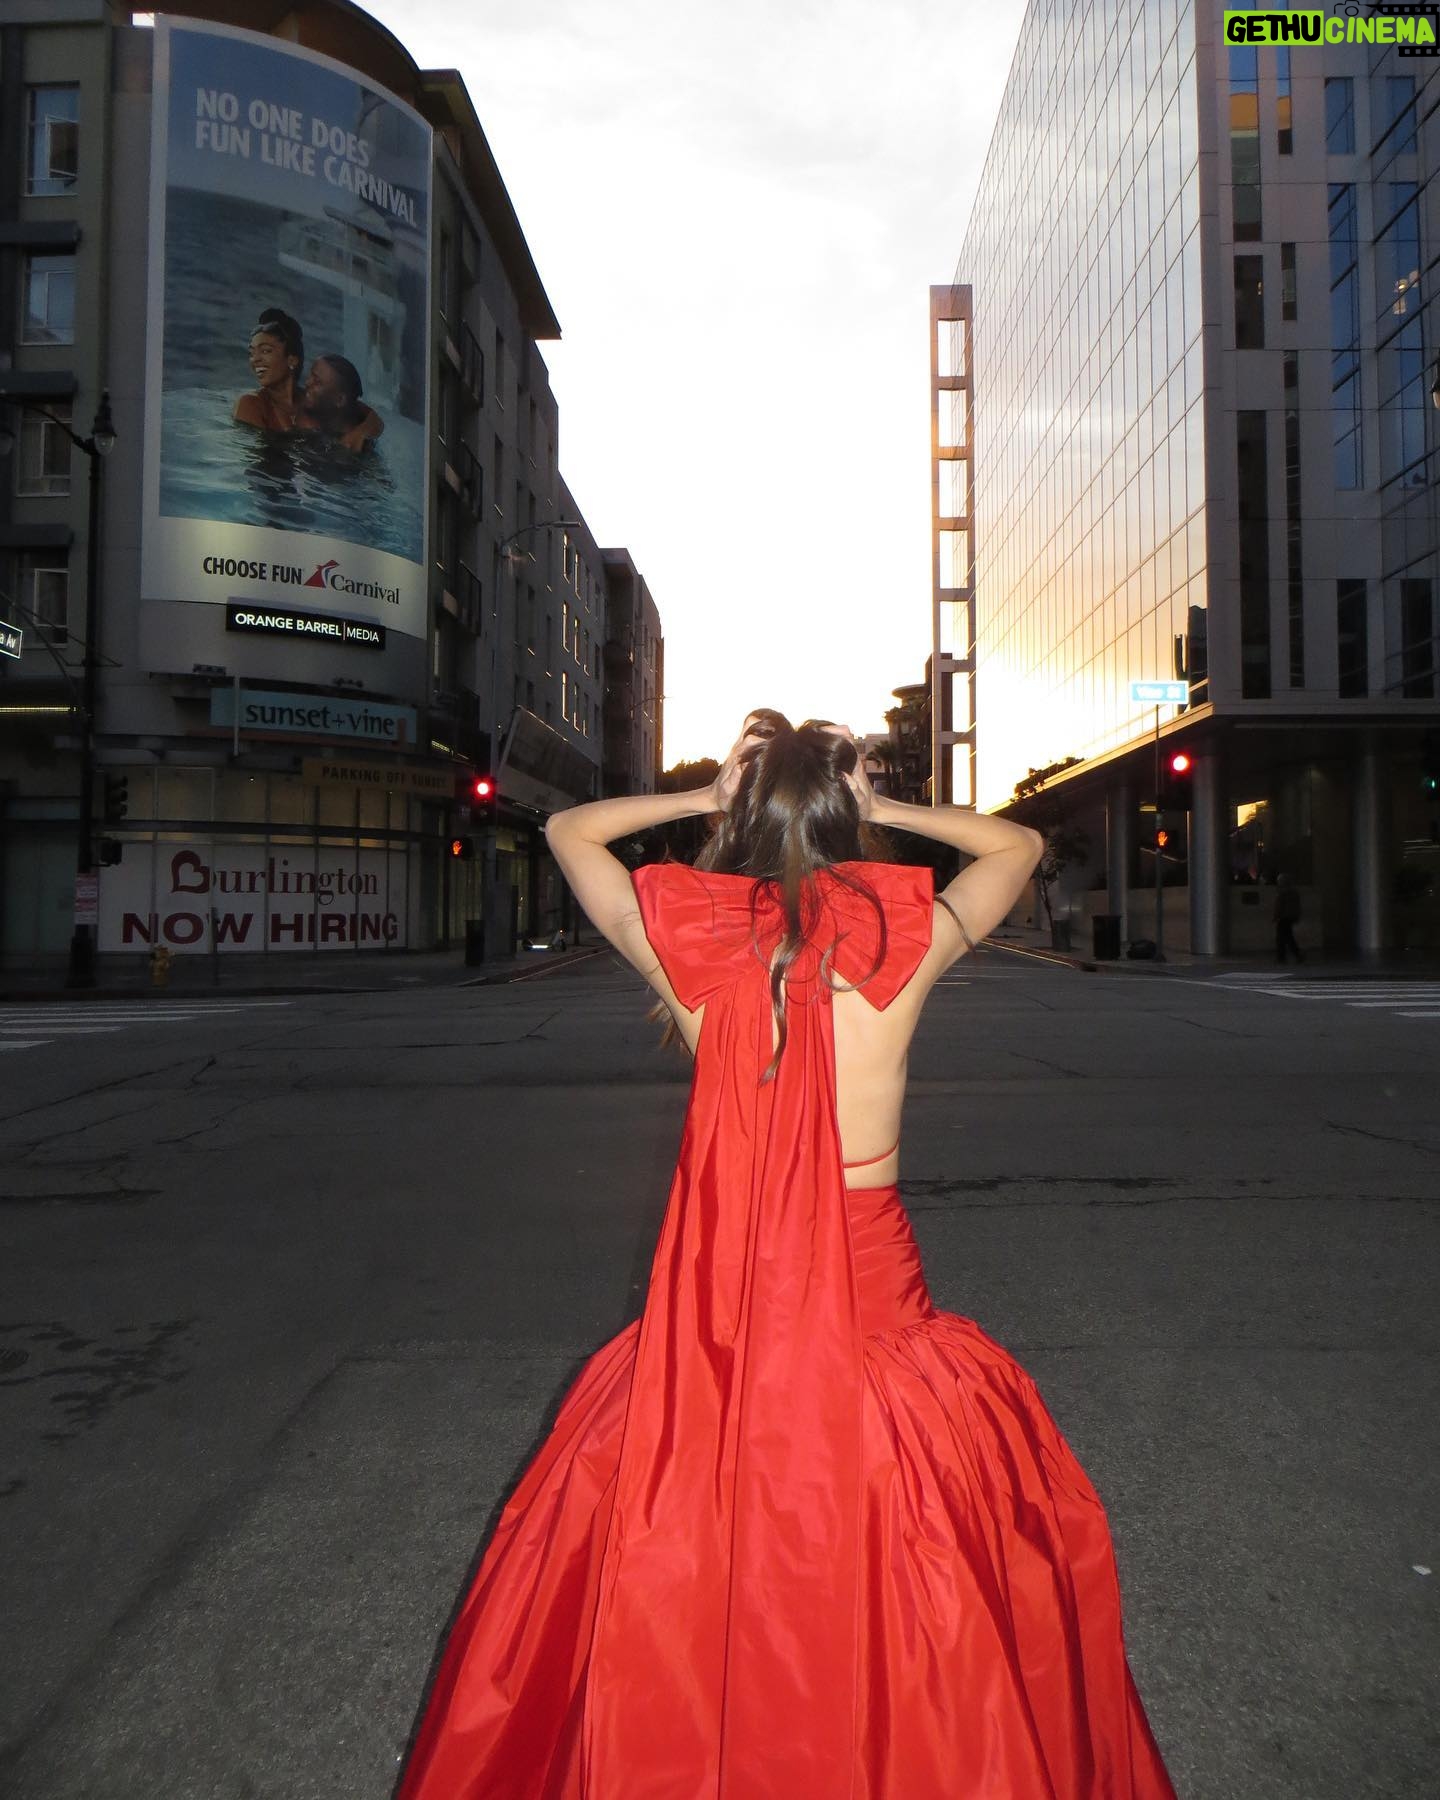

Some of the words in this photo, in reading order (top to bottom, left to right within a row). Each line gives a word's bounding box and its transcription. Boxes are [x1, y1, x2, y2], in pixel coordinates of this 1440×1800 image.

[196, 87, 240, 123] NO
[248, 99, 303, 141] ONE
[311, 117, 370, 168] DOES
[195, 120, 250, 158] FUN
[260, 133, 316, 177] LIKE
[323, 156, 417, 228] CARNIVAL
[202, 556, 267, 580] CHOOSE
[272, 564, 302, 585] FUN
[330, 574, 400, 604] Carnival
[234, 612, 293, 630] ORANGE
[296, 619, 342, 637] BARREL
[346, 627, 380, 643] MEDIA
[322, 766, 380, 783] PARKING
[171, 850, 378, 905] Burlington
[122, 912, 253, 944] NOW
[271, 912, 398, 943] HIRING
